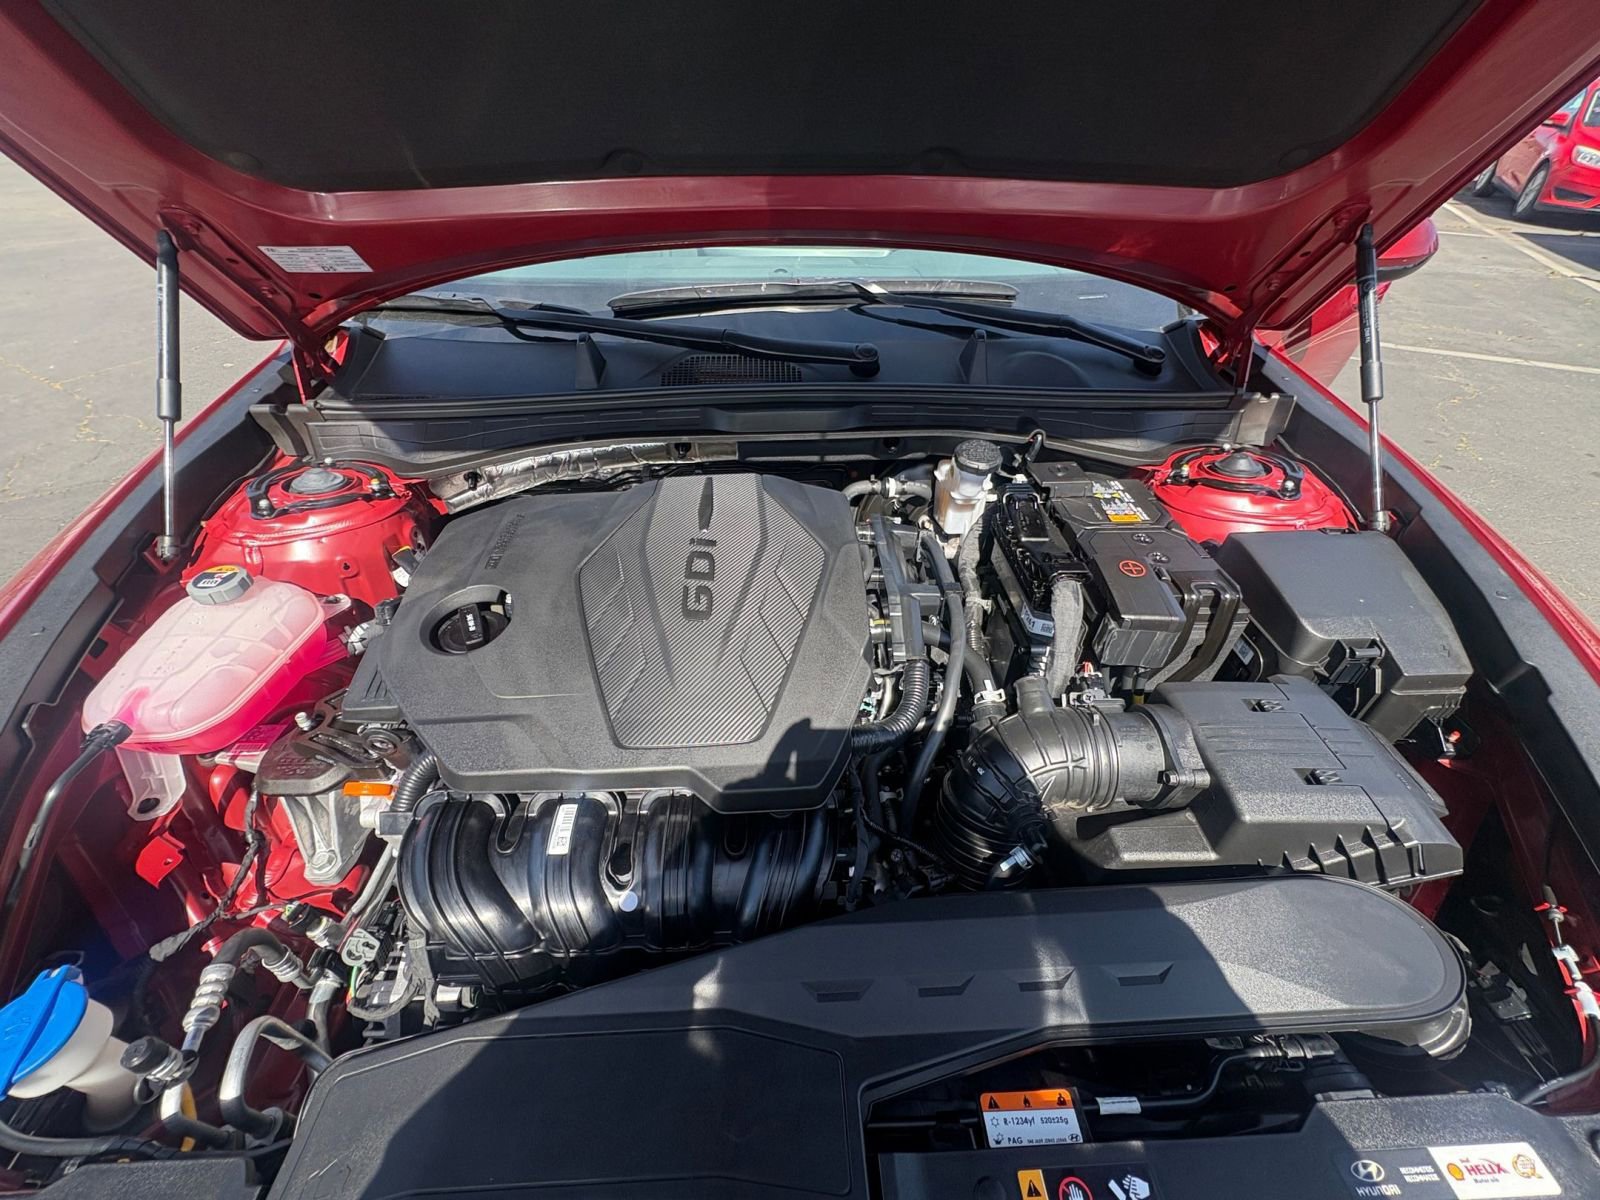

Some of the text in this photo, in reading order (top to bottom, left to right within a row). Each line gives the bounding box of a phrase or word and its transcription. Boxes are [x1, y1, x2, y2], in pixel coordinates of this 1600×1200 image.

[1007, 1136, 1023, 1145] PAG
[1464, 1163, 1508, 1176] HELIX
[1355, 1184, 1401, 1197] HYUNDAI
